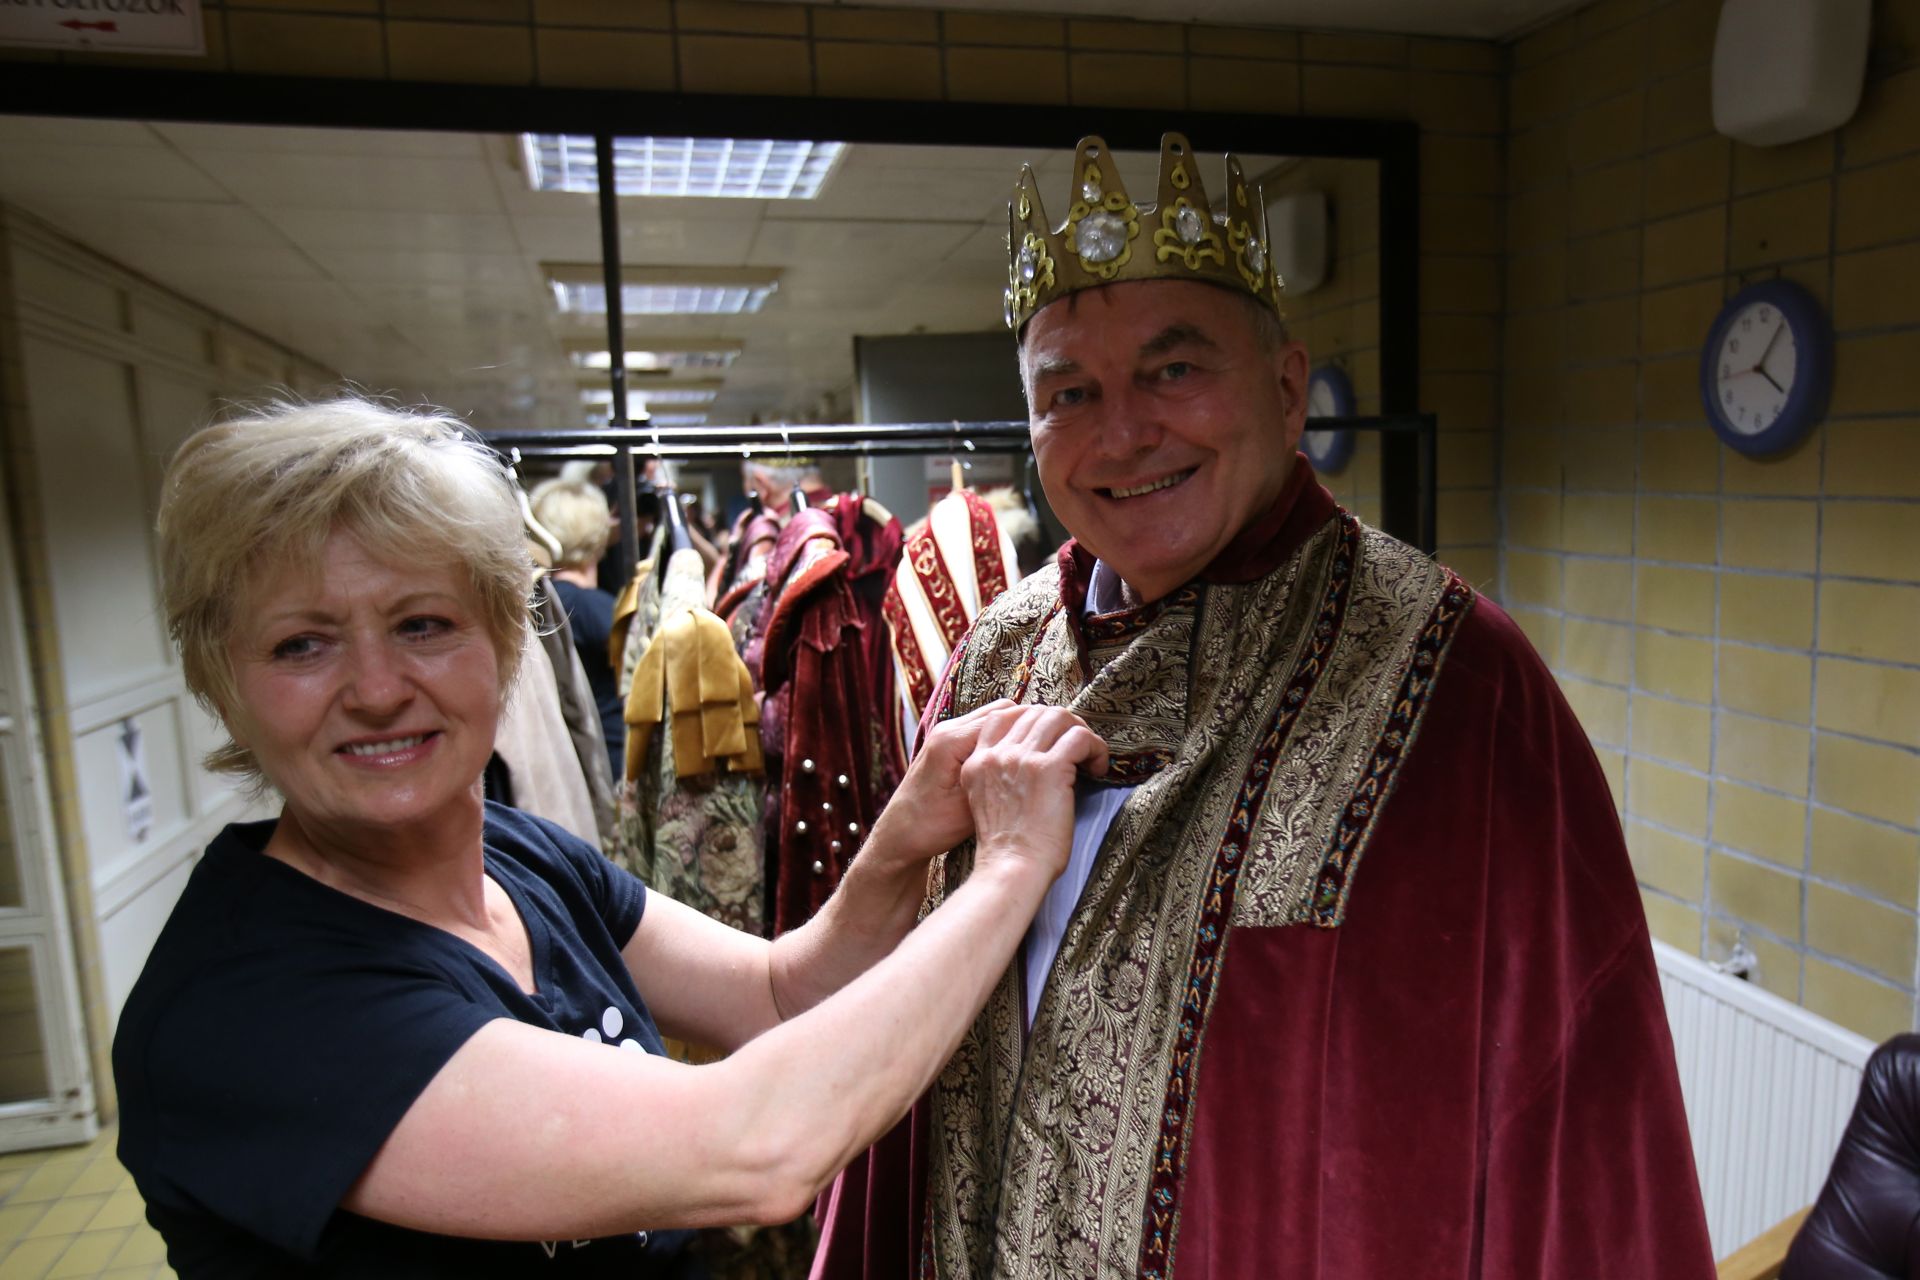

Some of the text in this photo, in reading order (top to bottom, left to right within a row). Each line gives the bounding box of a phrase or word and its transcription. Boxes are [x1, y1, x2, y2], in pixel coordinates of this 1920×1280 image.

[1759, 307, 1770, 323] 12
[1742, 318, 1752, 332] 11
[1729, 338, 1739, 354] 10
[1739, 406, 1746, 421] 7
